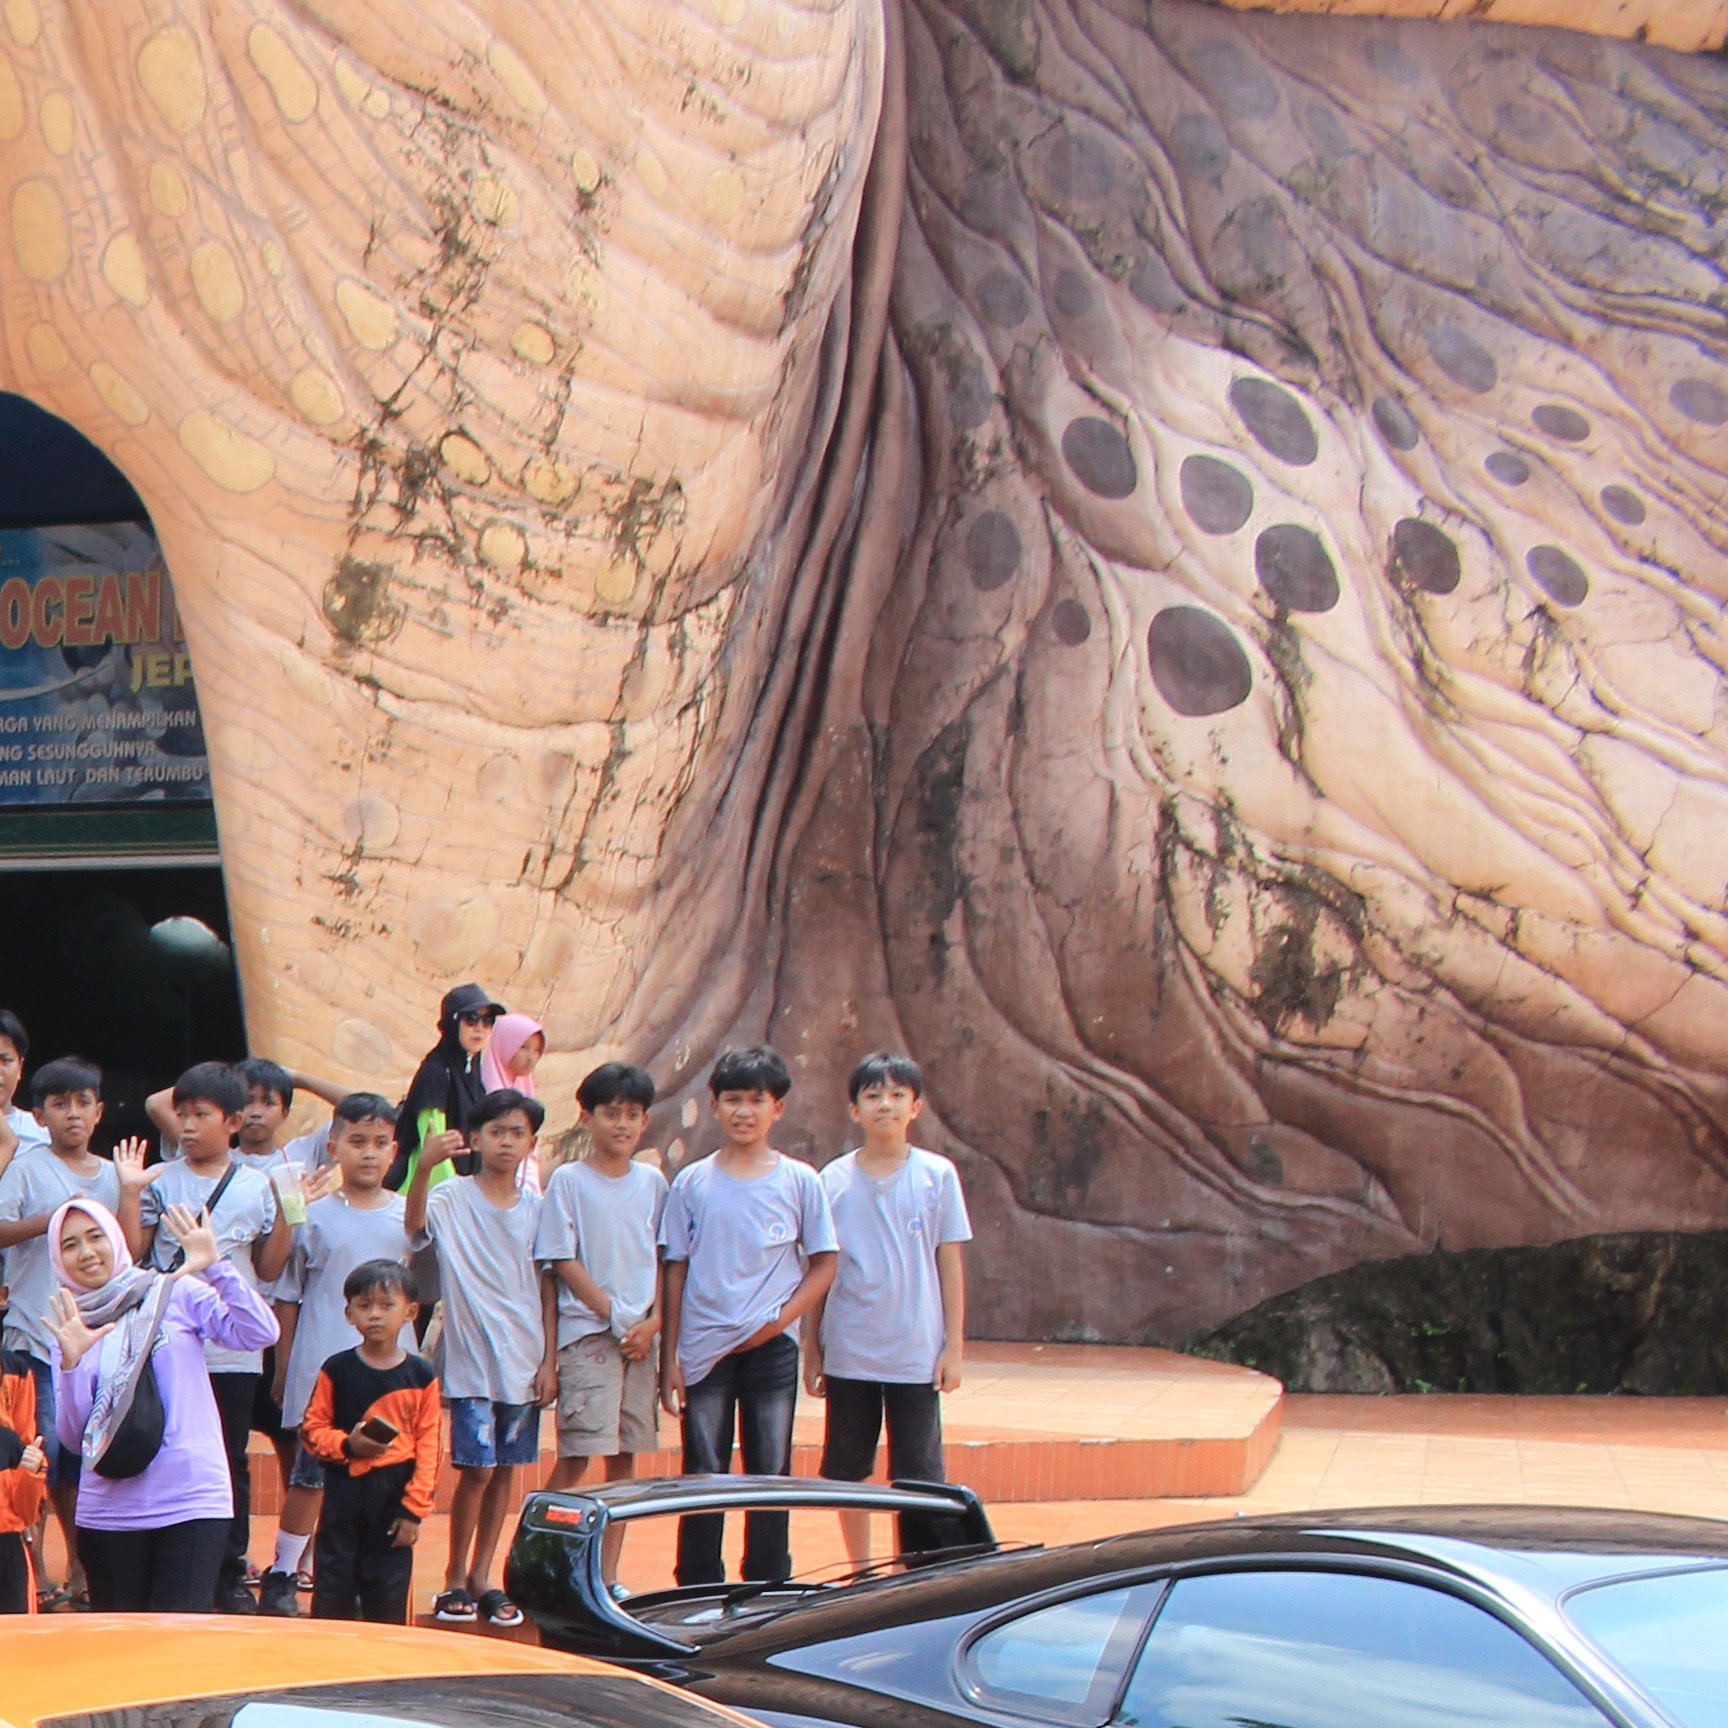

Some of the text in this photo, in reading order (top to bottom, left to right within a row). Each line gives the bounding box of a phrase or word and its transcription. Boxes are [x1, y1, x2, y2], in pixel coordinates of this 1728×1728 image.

[33, 716, 76, 732] YANG
[82, 710, 197, 731] MENAMPILKAN
[27, 740, 157, 761] SESUNGGUHNYA
[36, 768, 77, 786] LAUT
[85, 767, 120, 783] DAN
[126, 764, 204, 782] TERUMBU
